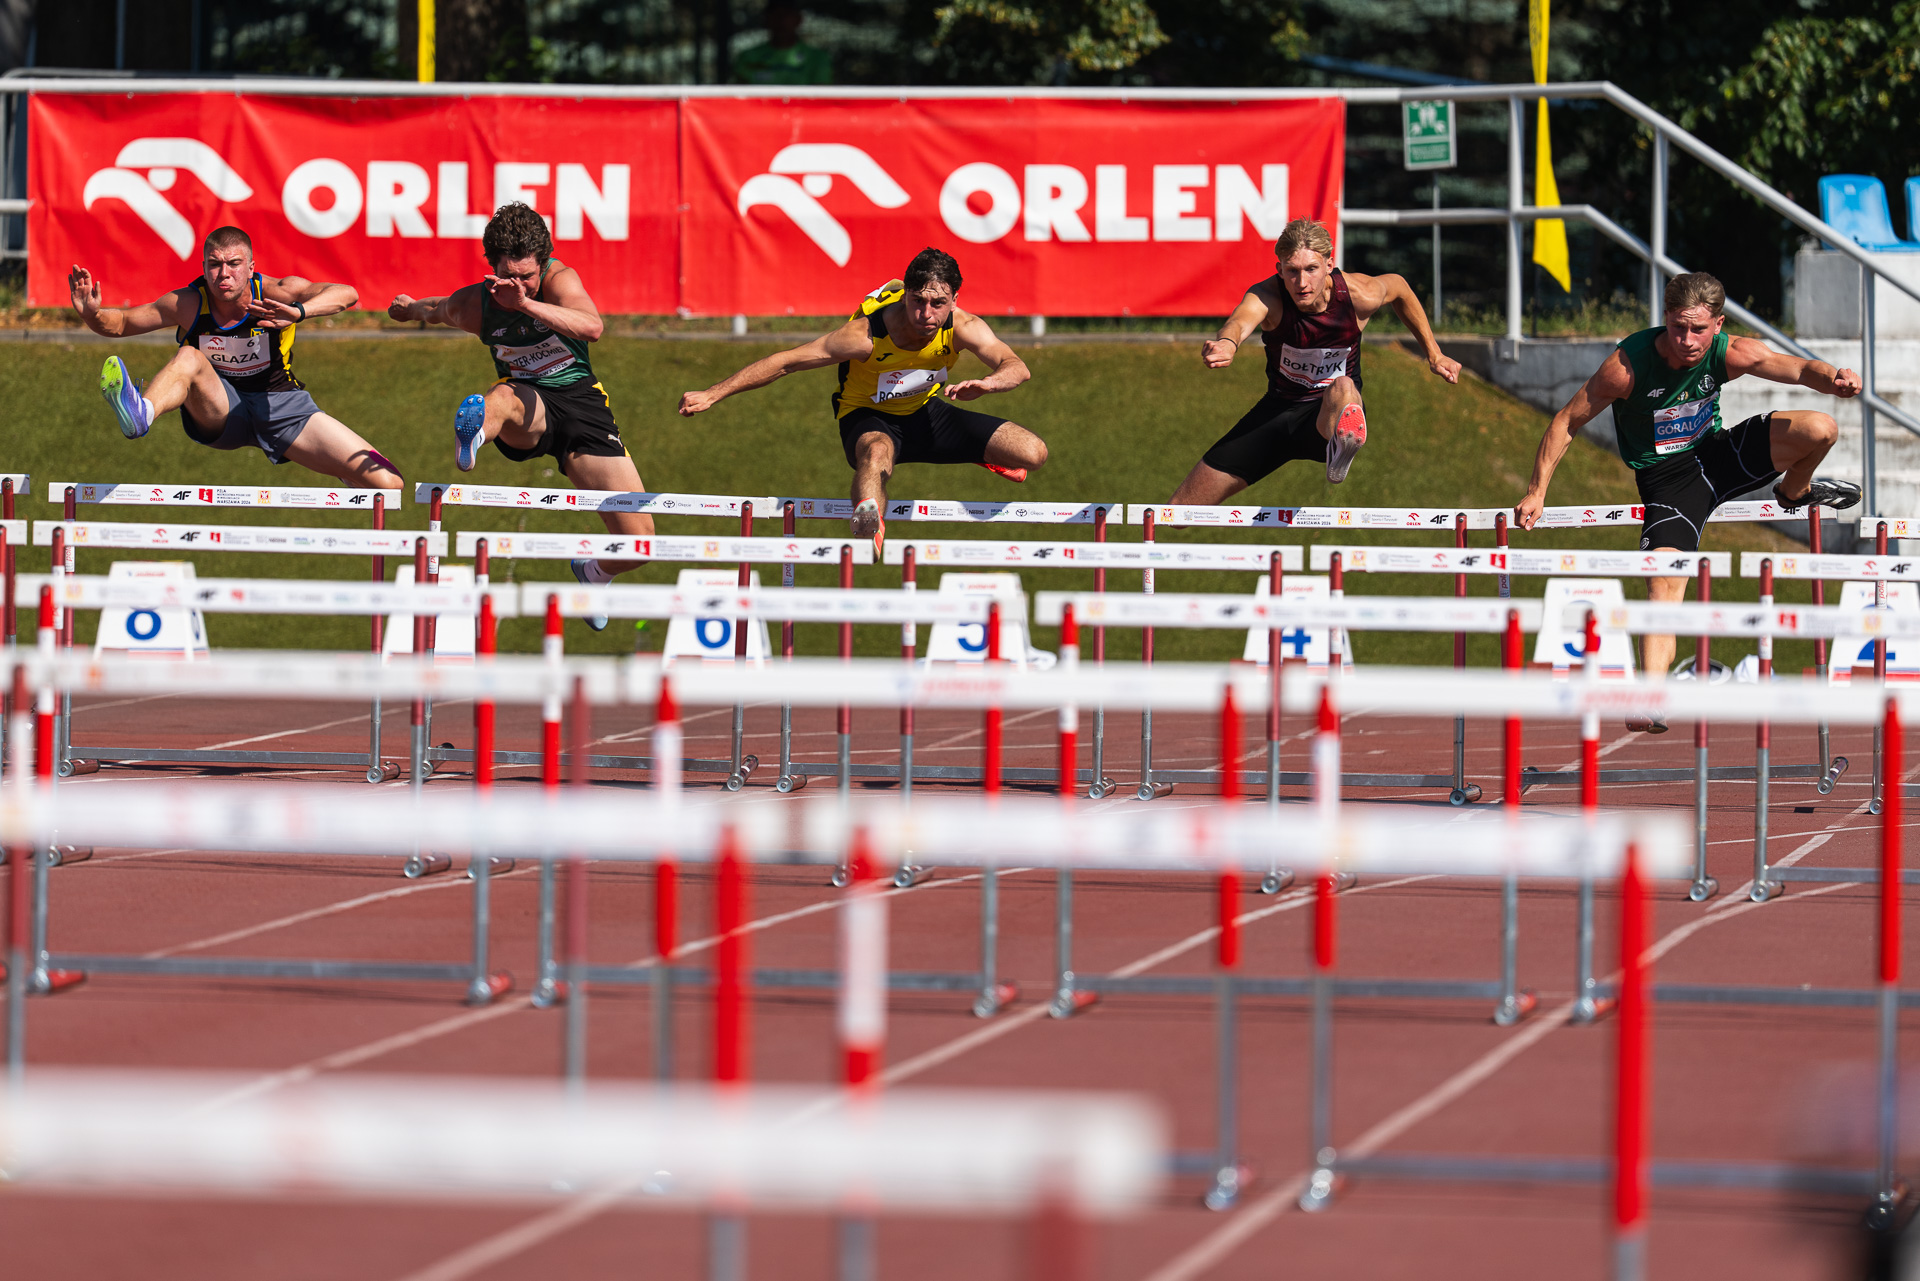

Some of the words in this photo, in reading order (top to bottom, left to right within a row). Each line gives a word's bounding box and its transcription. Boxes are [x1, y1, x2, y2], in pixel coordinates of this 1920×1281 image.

[281, 157, 631, 241] ORLEN
[939, 162, 1290, 244] ORLEN
[246, 339, 255, 347] 6
[211, 352, 260, 364] GLAZA
[1323, 350, 1340, 359] 26
[1283, 356, 1342, 376] BOŁTRYK
[926, 373, 935, 382] 4
[1647, 388, 1666, 397] 4F
[1656, 403, 1712, 436] GÓRALCZYK
[172, 491, 192, 501] 4F
[349, 495, 368, 504] 4F
[540, 494, 560, 505] 4F
[892, 505, 912, 515] 4F
[1605, 510, 1624, 520] 4F
[1252, 512, 1271, 522] 4F
[1430, 514, 1449, 524] 4F
